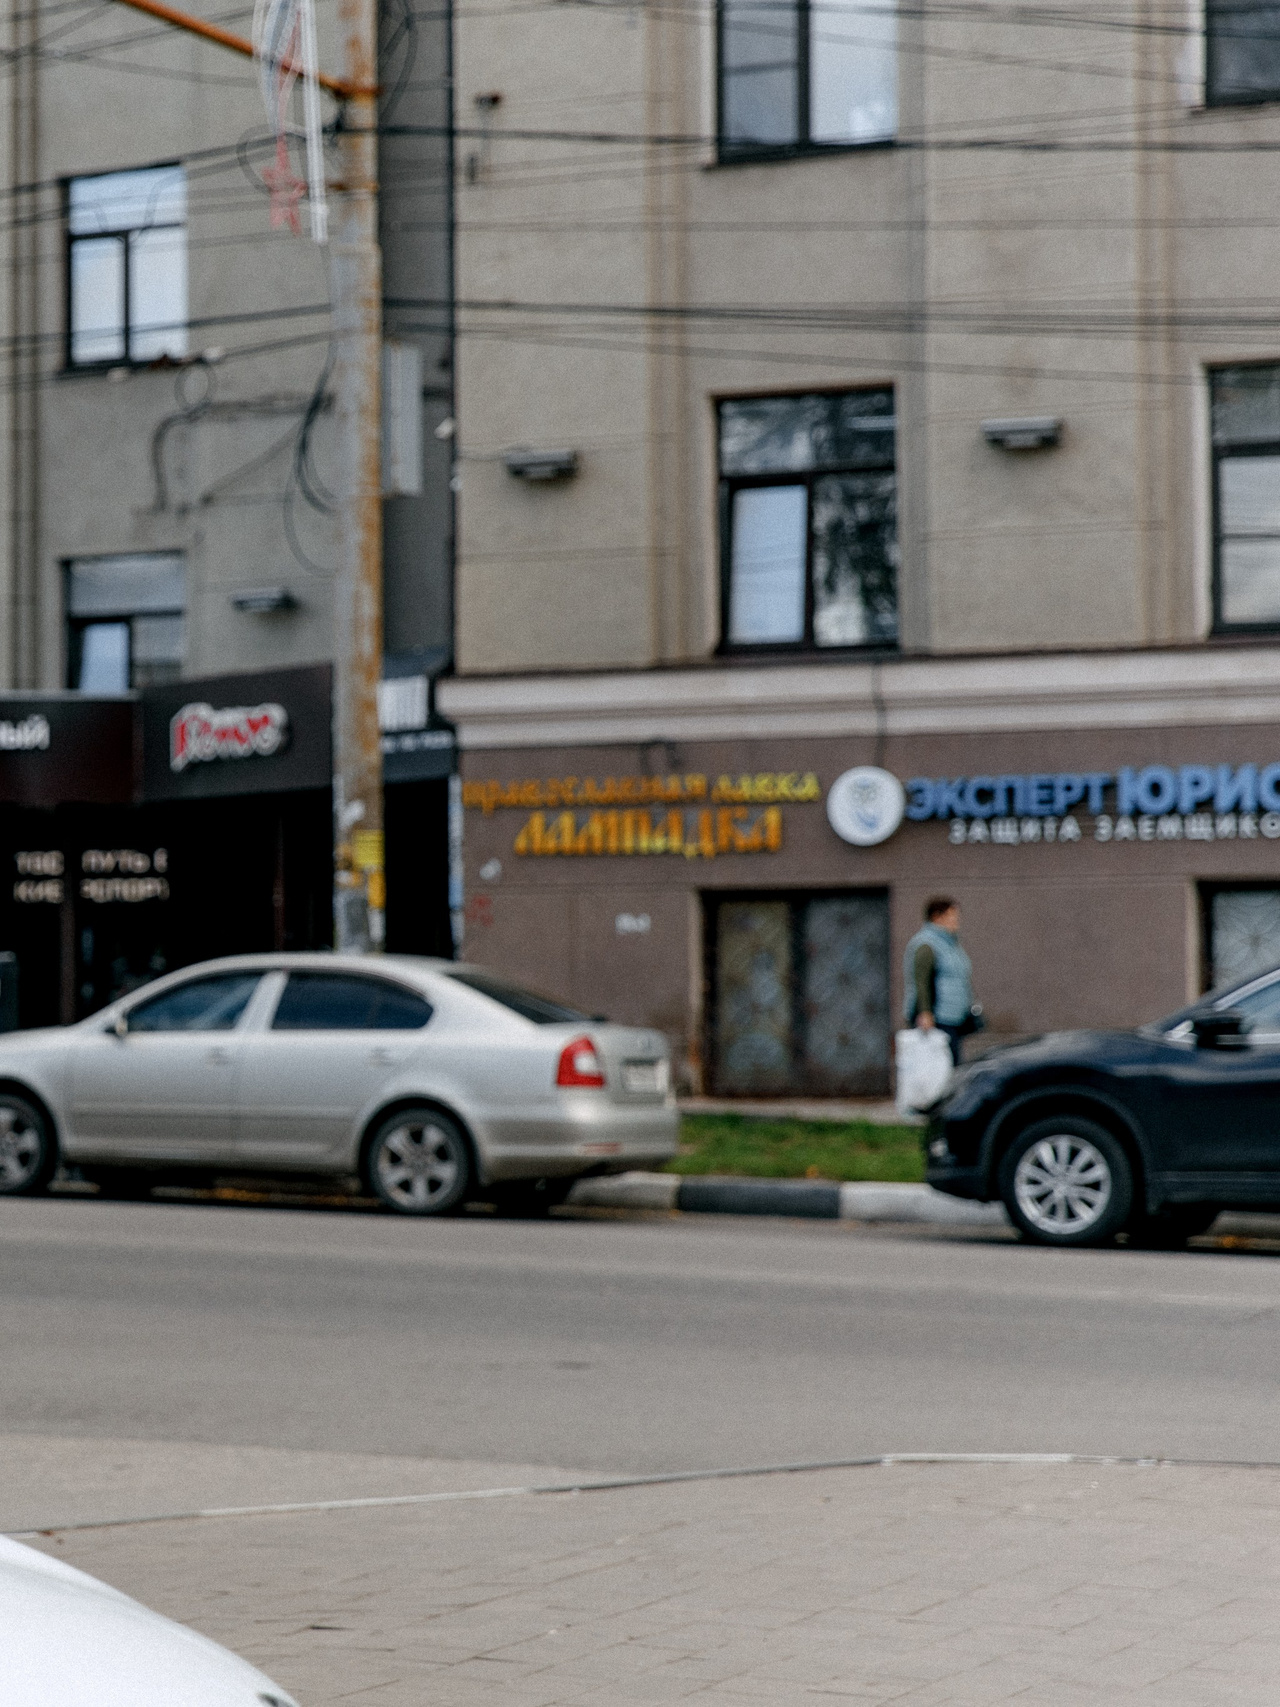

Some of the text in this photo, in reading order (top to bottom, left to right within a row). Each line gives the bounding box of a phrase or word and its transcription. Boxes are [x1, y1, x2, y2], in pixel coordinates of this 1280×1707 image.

[905, 772, 1114, 822] ЭКСПЕРТ
[948, 810, 1280, 846] ЗАЩИТА ЗАЕМЩИКО
